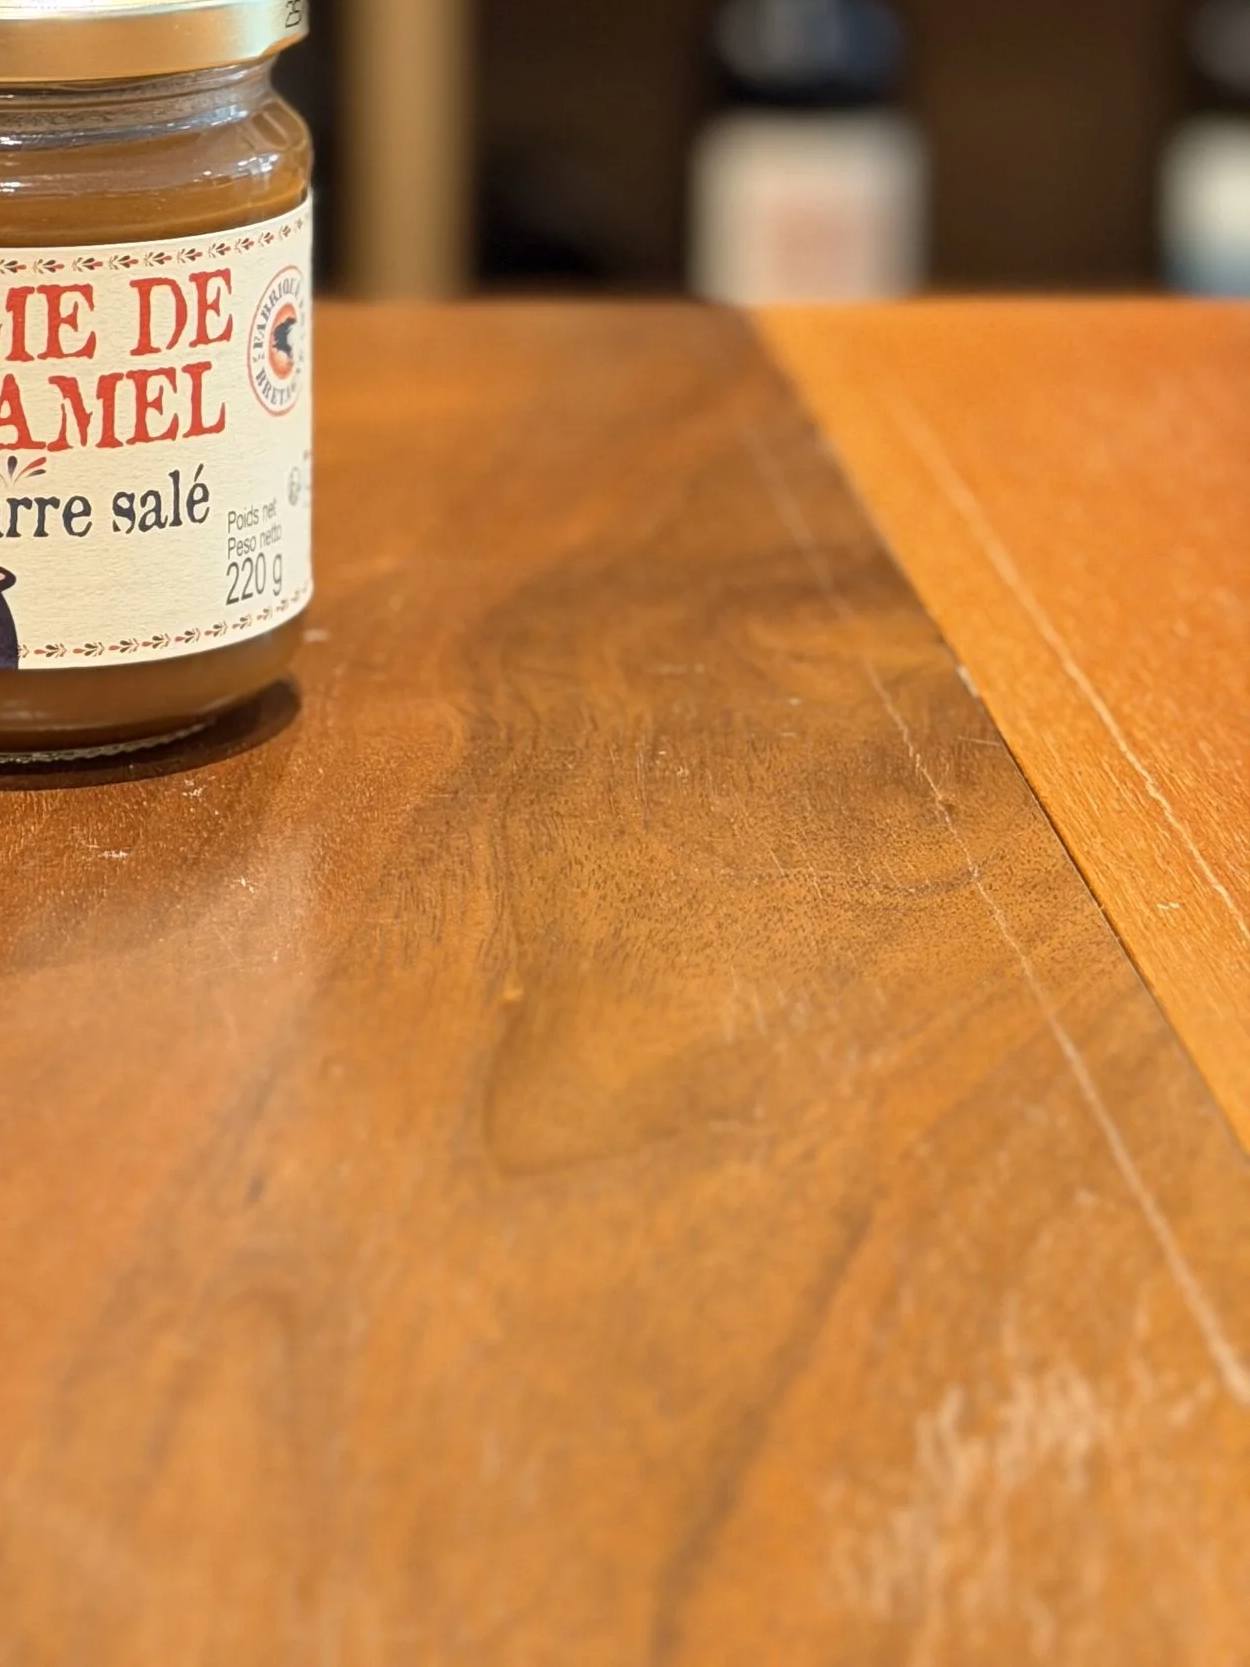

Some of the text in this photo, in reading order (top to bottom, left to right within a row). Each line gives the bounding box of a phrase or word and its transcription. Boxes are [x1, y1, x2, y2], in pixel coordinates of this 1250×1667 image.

[129, 268, 233, 356] DE
[112, 463, 210, 534] salé
[227, 497, 277, 534] Poids net
[227, 523, 282, 560] Peso netto
[225, 552, 283, 606] 220 g
